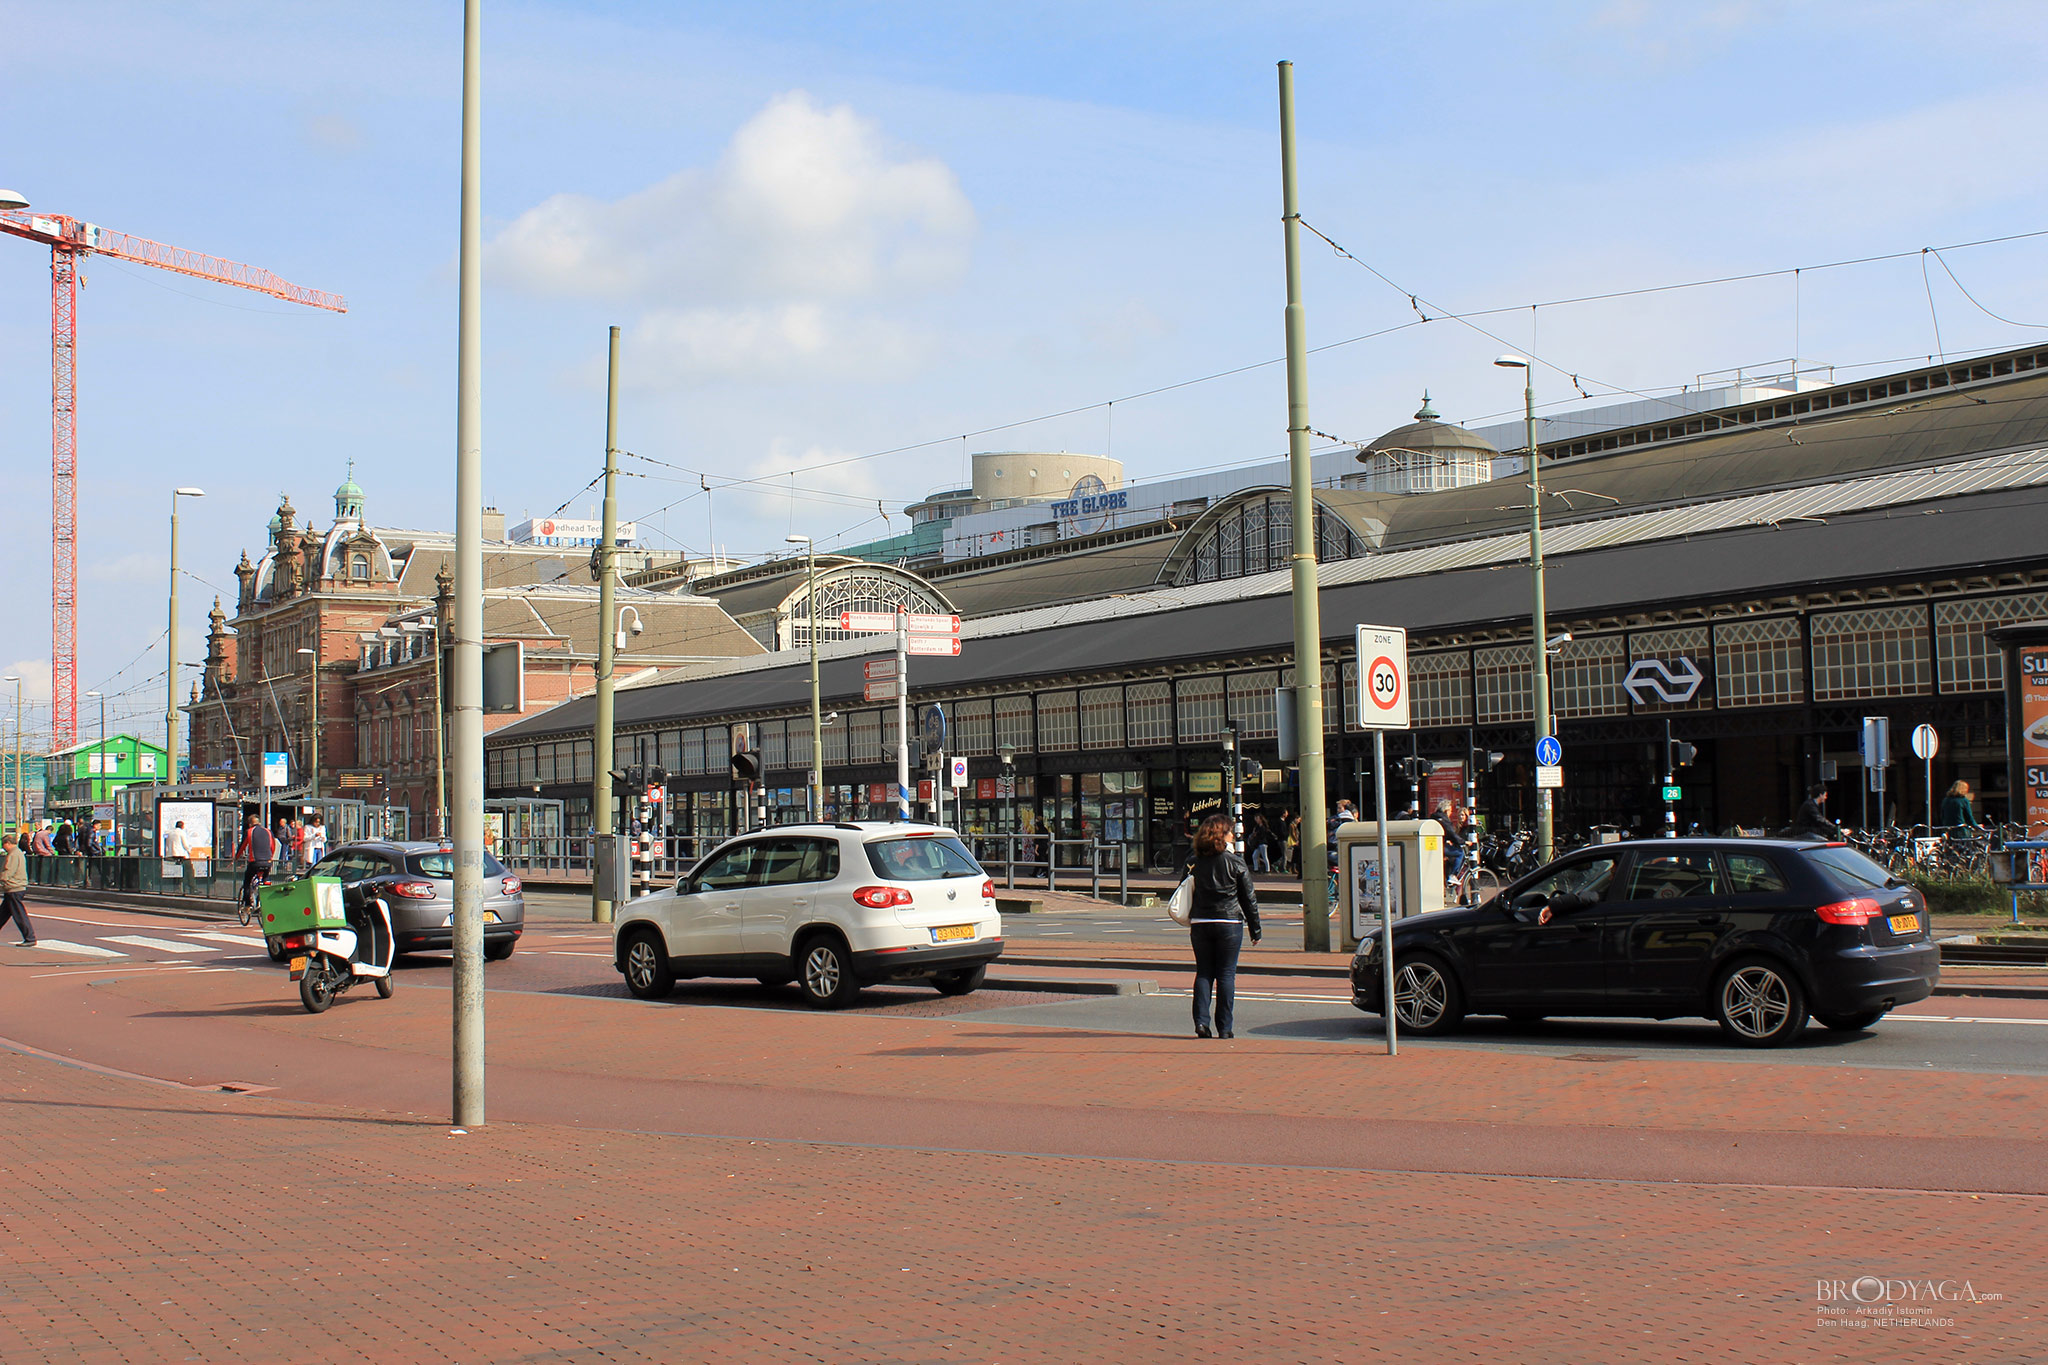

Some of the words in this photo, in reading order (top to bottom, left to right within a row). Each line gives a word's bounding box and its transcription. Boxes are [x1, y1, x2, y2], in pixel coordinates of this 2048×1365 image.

[1051, 499, 1078, 519] THE
[1082, 491, 1127, 514] GLOBE
[587, 524, 632, 536] Techogy
[1374, 634, 1392, 645] ZONE
[1375, 673, 1395, 693] 30
[1667, 789, 1679, 798] 26
[1192, 797, 1222, 813] kibbeling
